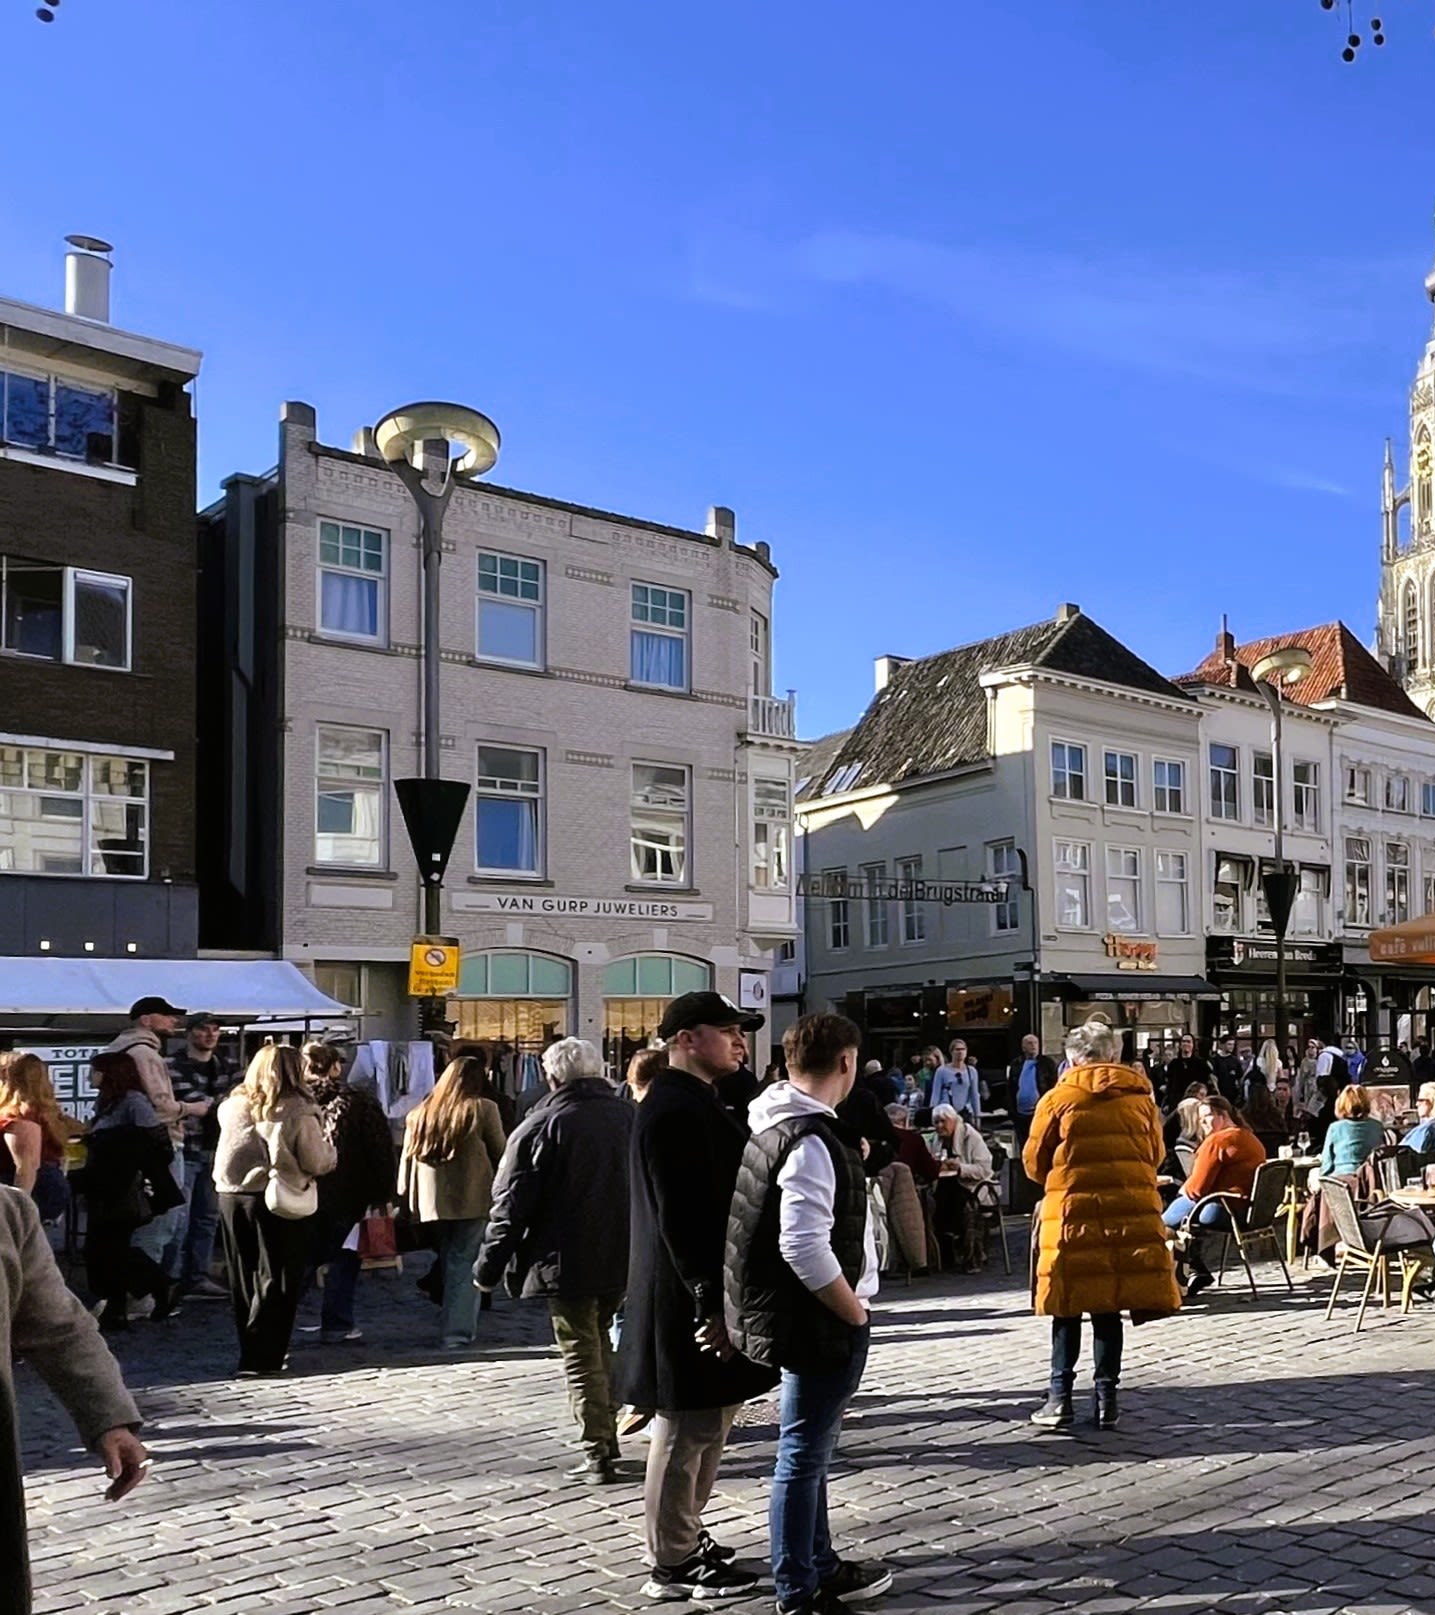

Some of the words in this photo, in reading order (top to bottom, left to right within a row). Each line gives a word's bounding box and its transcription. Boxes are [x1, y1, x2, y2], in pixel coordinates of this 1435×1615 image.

[497, 897, 534, 911] VAN
[541, 900, 588, 913] GURP
[593, 903, 679, 918] JUWELIERS
